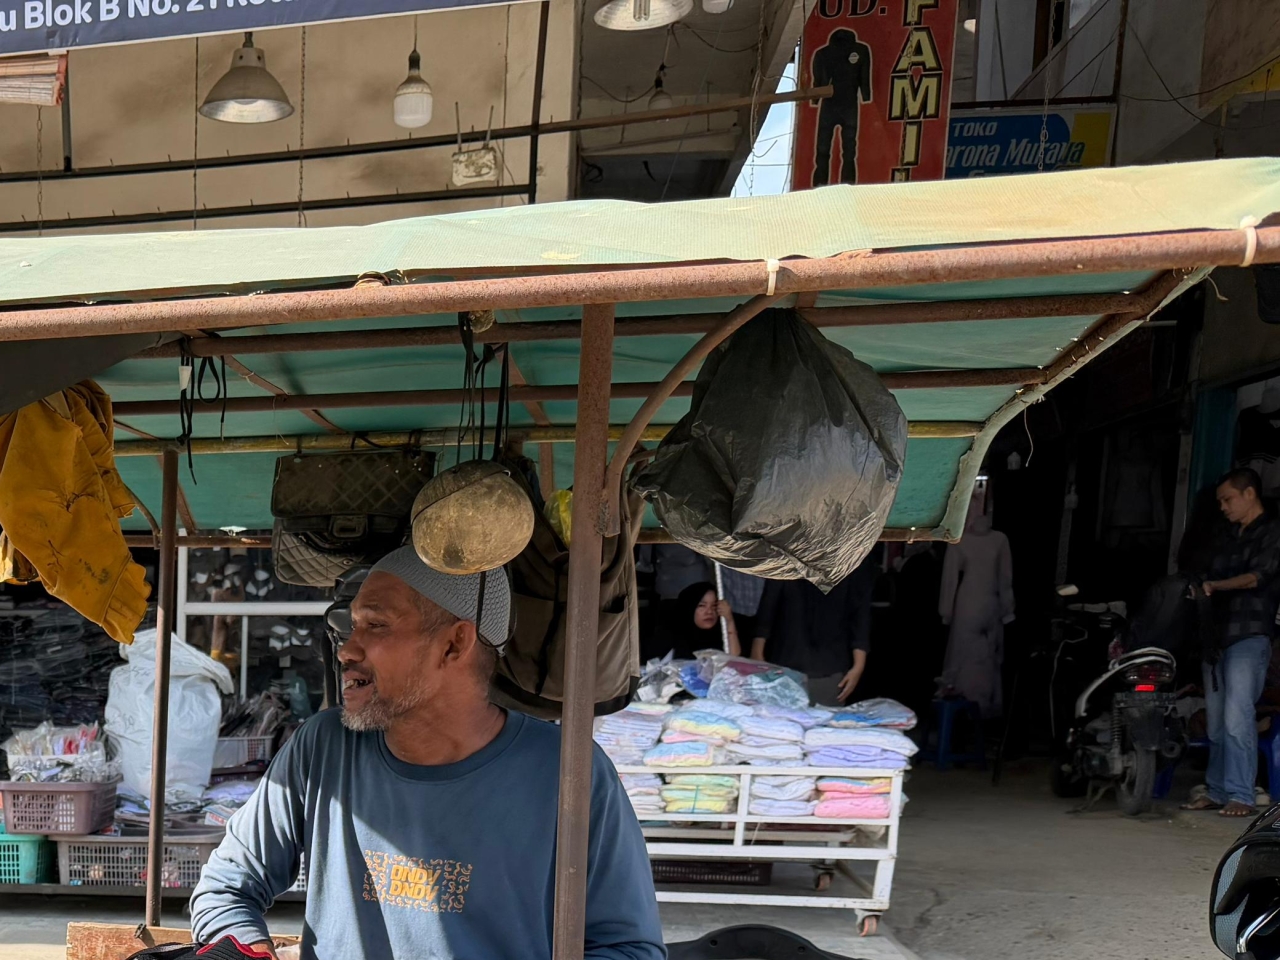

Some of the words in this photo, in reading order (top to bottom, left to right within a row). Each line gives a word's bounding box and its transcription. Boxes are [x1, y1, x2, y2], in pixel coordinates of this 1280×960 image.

[24, 0, 93, 30] Blok
[99, 0, 120, 22] B
[952, 121, 998, 137] TOKO
